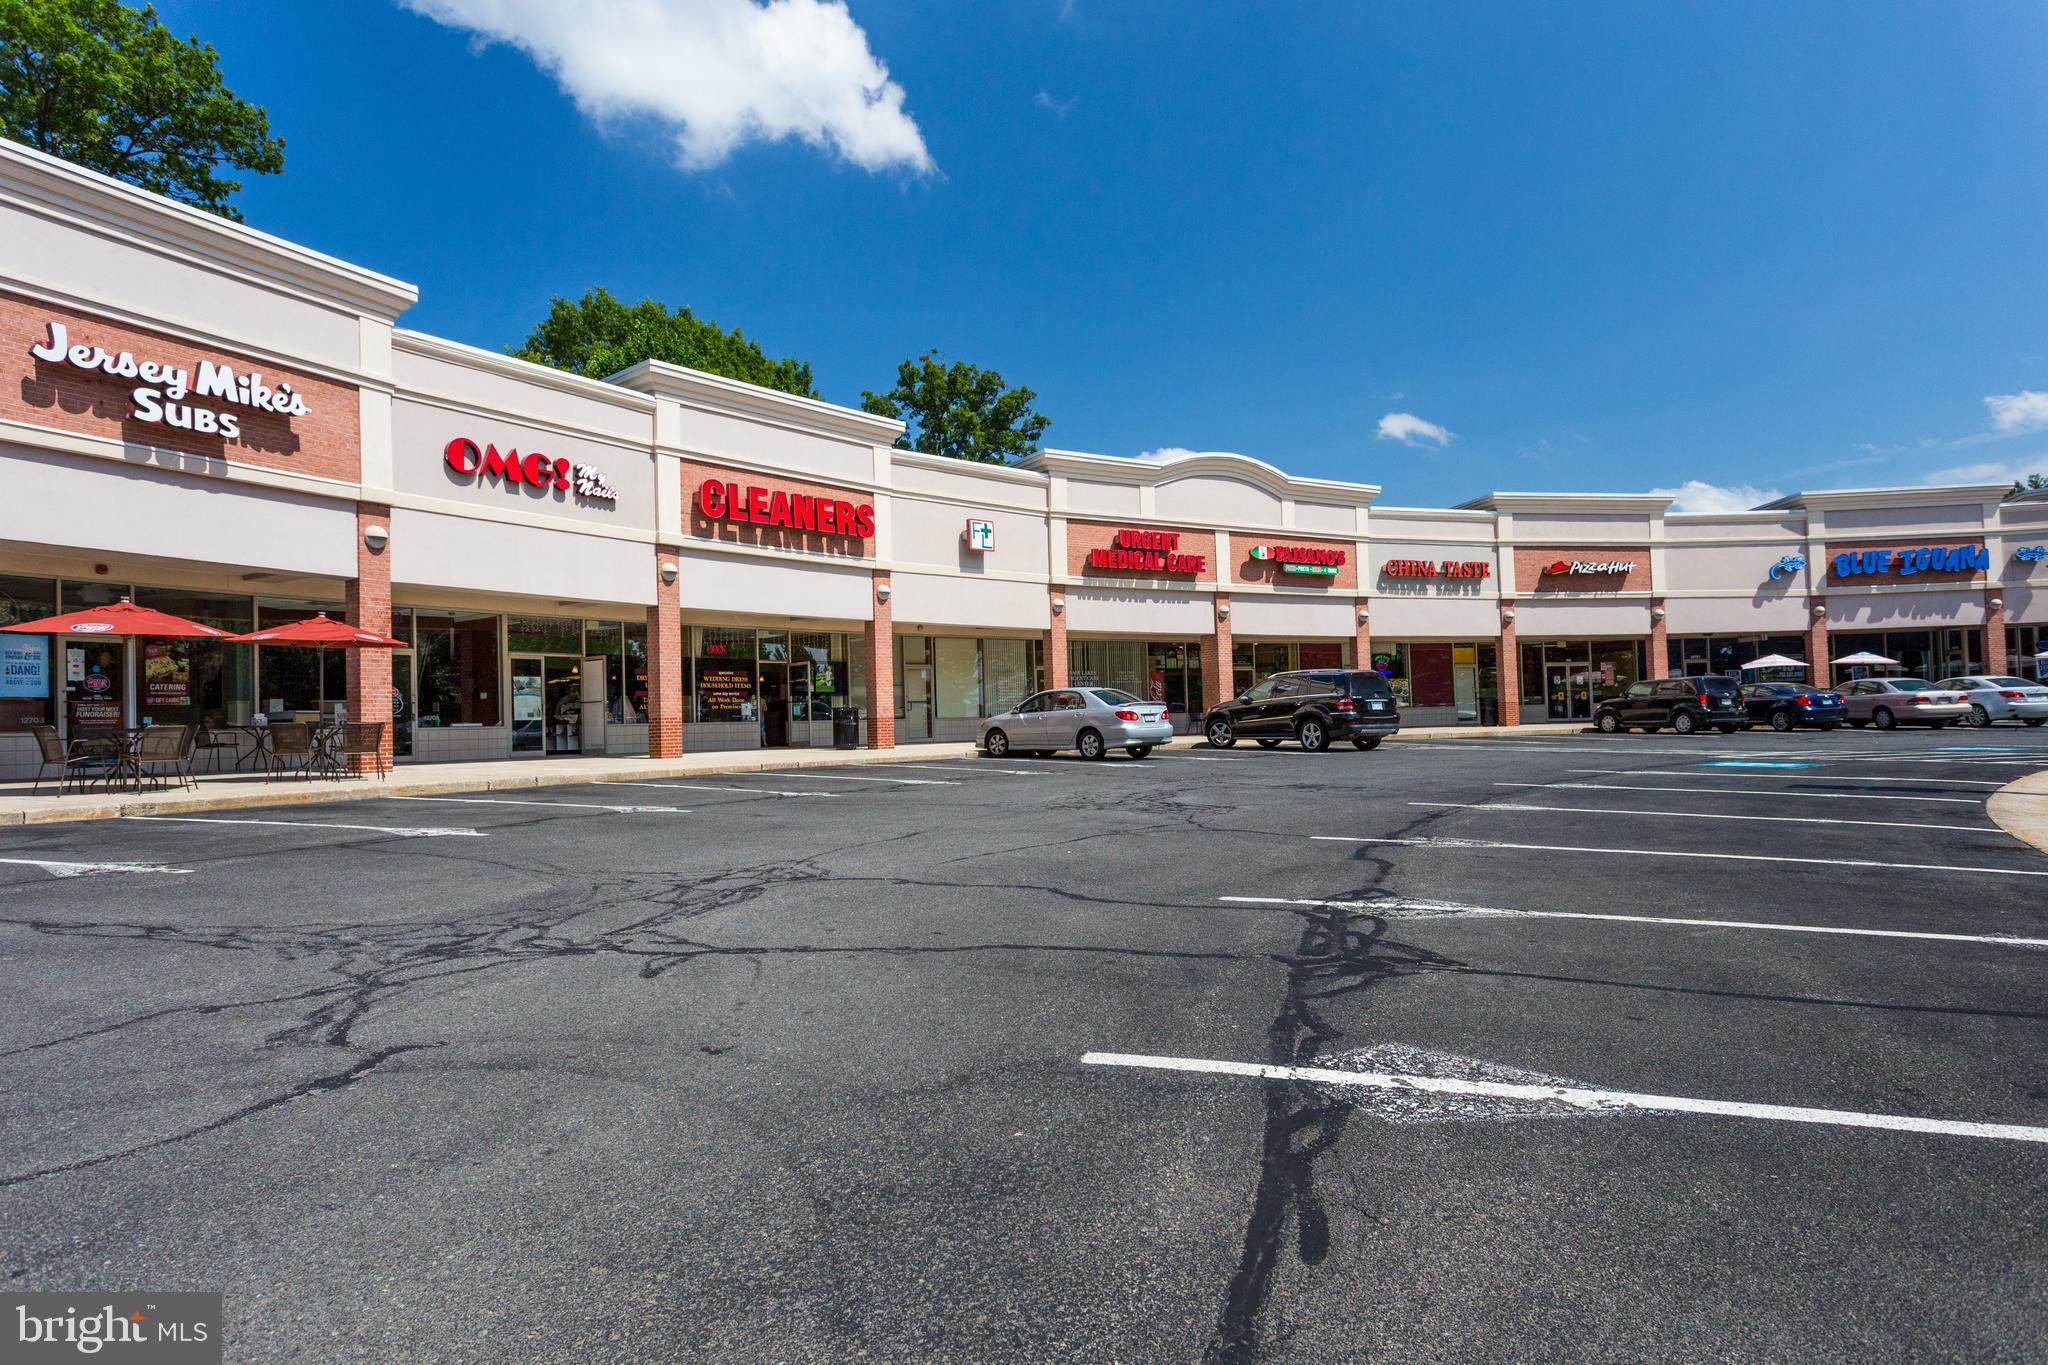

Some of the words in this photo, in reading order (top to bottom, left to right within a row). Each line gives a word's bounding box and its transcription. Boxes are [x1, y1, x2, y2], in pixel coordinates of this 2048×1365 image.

[31, 320, 189, 400] Jersey
[195, 359, 312, 418] Mike's
[445, 437, 571, 491] OMG!
[576, 478, 620, 500] Nails
[701, 478, 875, 539] CLEANERS
[1118, 529, 1180, 551] URGENT
[1091, 548, 1164, 571] MEDICAL
[1166, 553, 1206, 573] CARE
[1273, 545, 1346, 566] PAISANO'S
[1833, 549, 1893, 577] BLUE
[1897, 544, 1990, 576] IGUANA
[1386, 559, 1439, 577] CHINA
[1442, 560, 1491, 578] TASTE
[1569, 560, 1607, 575] Pizza
[10, 664, 41, 676] DANG!
